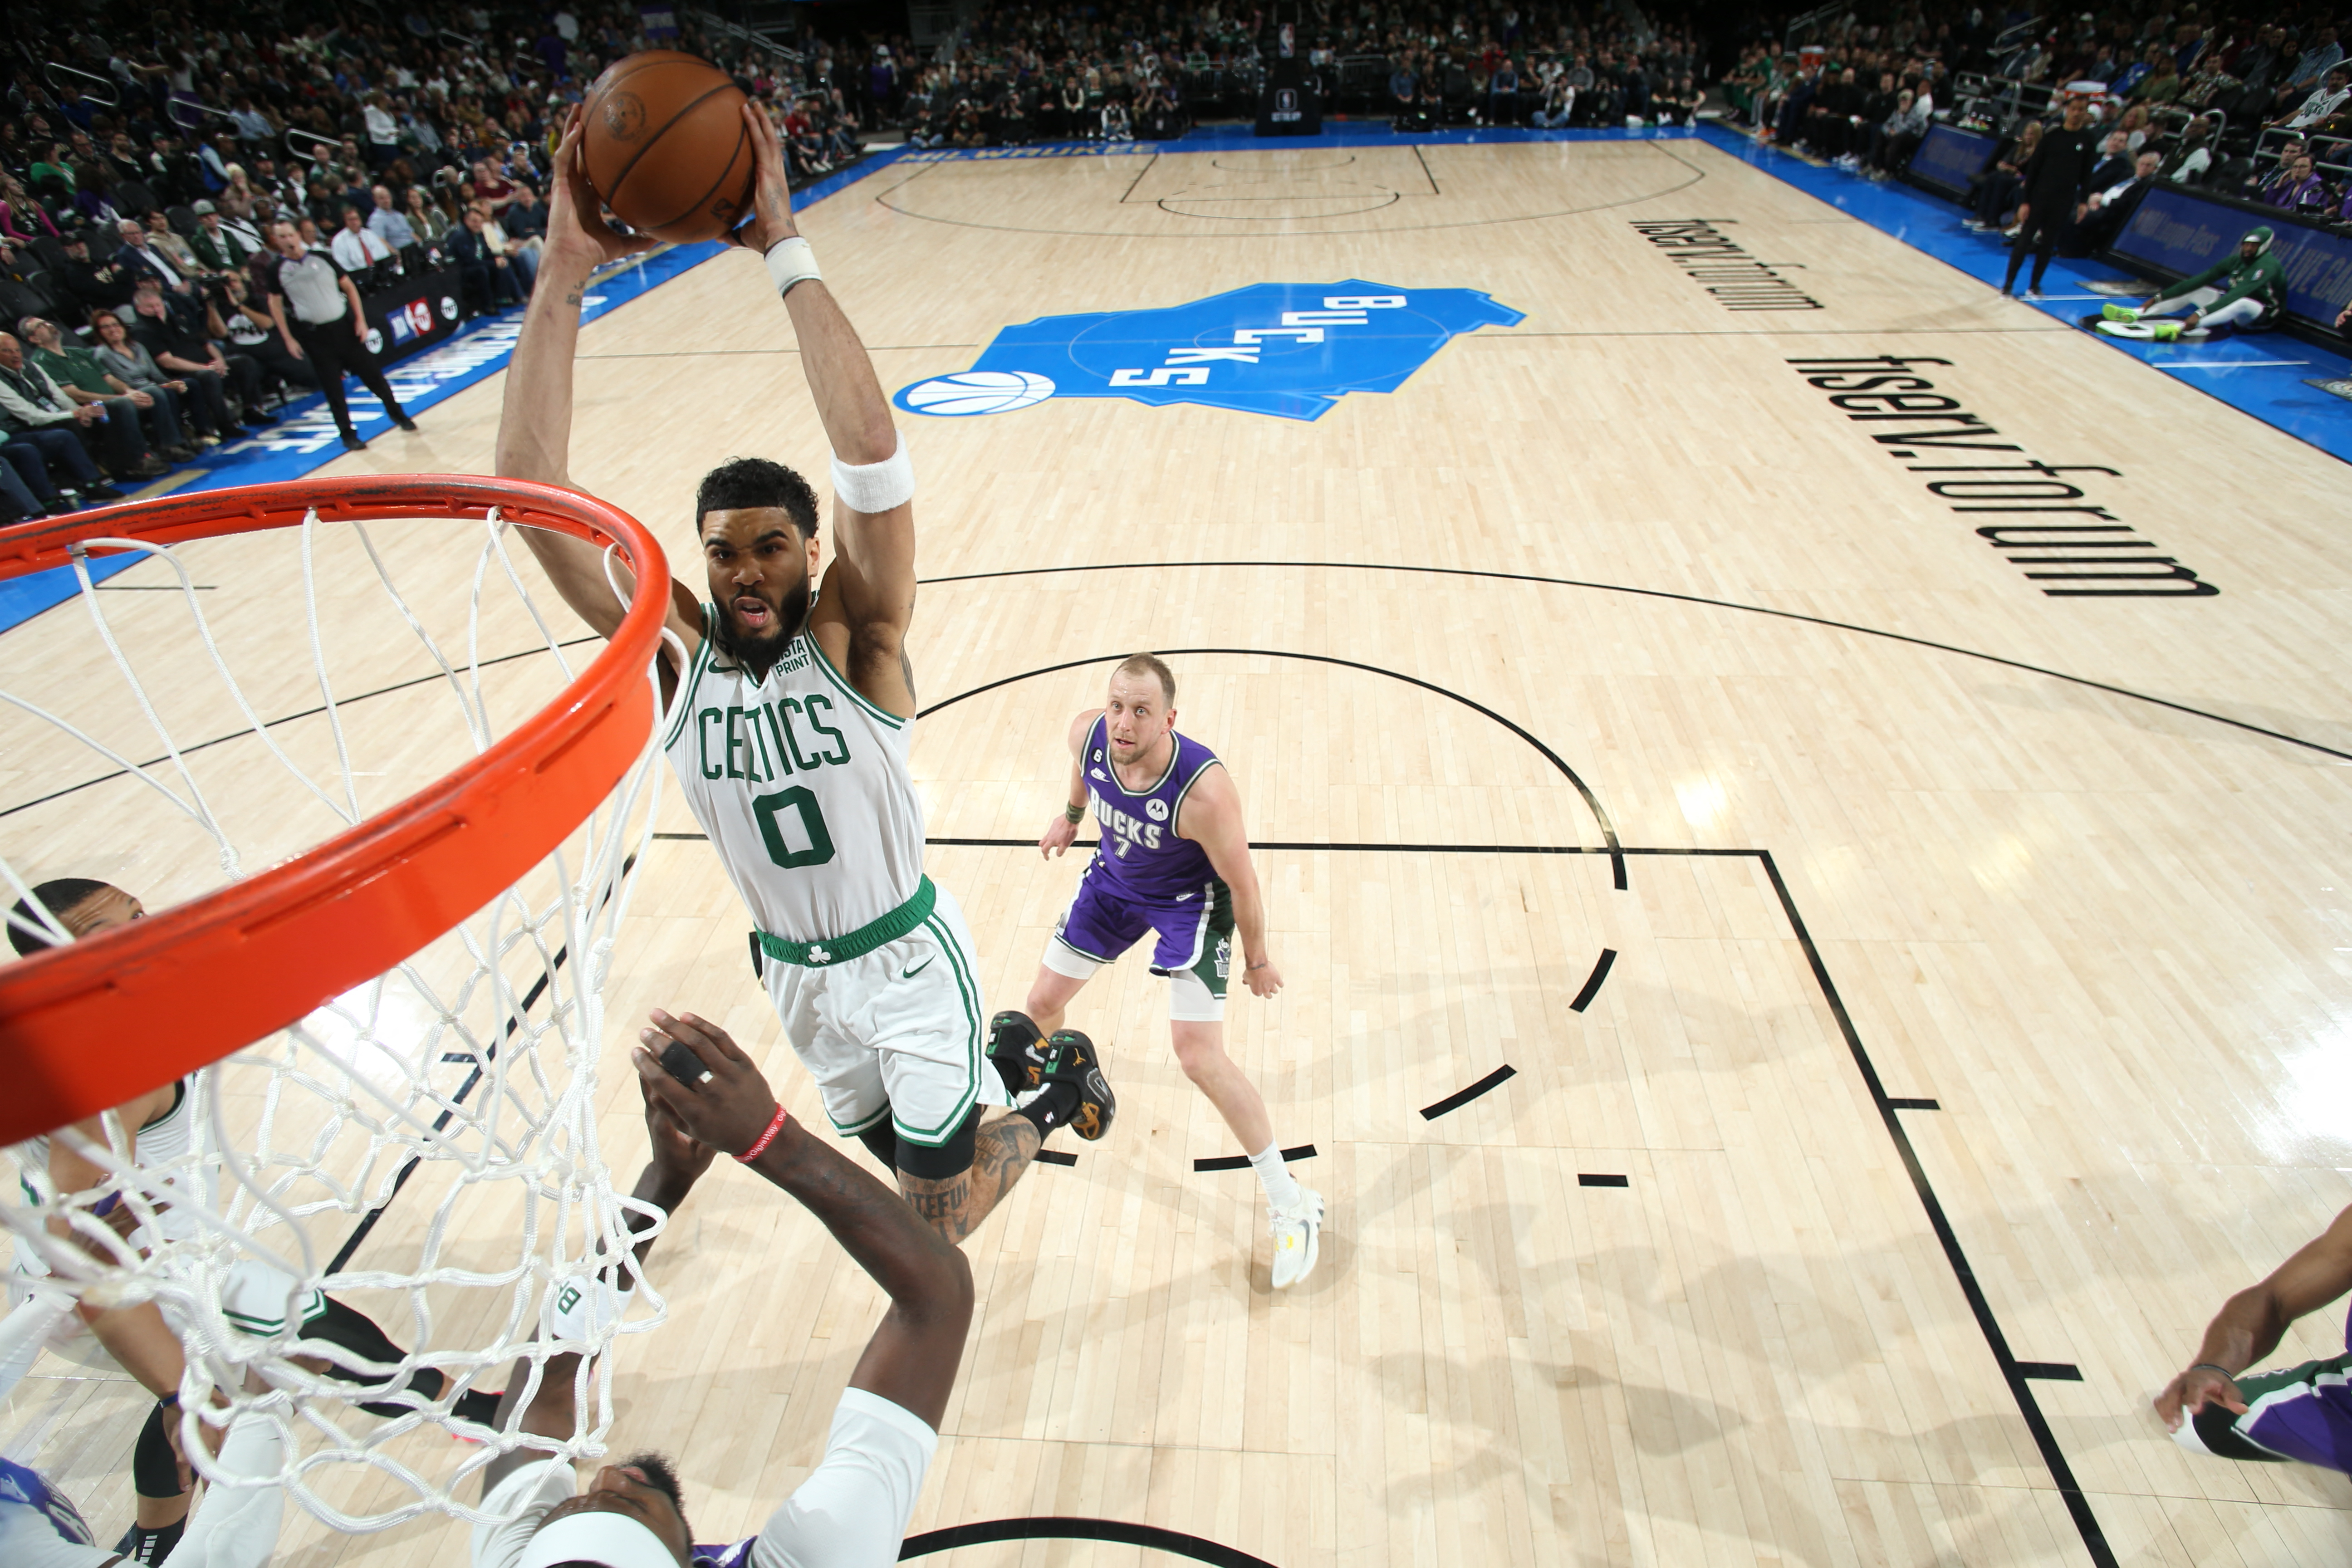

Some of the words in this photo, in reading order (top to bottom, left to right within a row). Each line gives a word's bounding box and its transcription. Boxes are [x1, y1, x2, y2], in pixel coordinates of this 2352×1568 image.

[1109, 294, 1407, 387] BUCKS
[776, 653, 809, 677] PRINT
[1093, 749, 1103, 763] 6
[1093, 767, 1107, 779] NIKE
[752, 785, 836, 870] 0
[1087, 782, 1164, 850] BUCKS
[1113, 834, 1132, 859] 7
